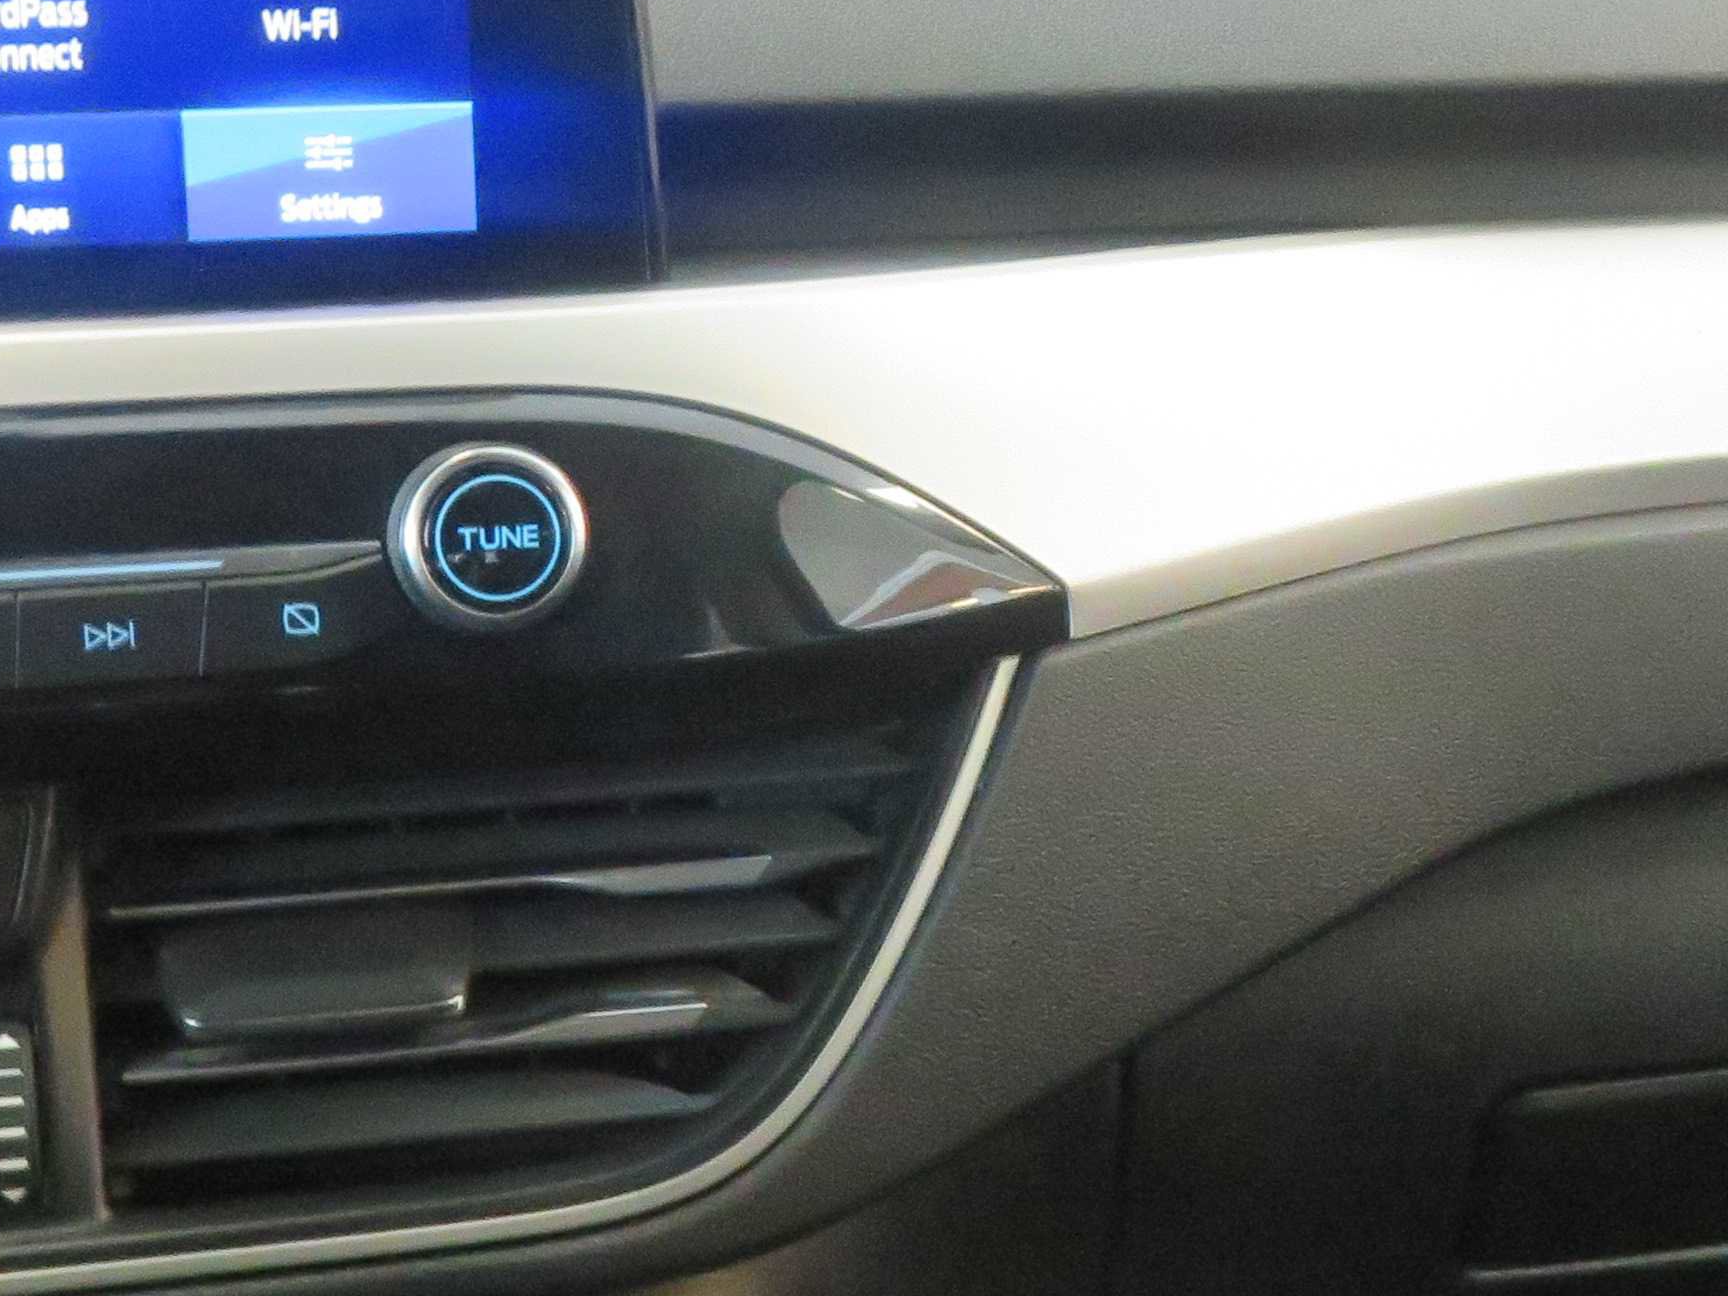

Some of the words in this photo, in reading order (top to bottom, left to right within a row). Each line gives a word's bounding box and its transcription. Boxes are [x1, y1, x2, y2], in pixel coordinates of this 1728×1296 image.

[262, 7, 339, 42] Wi-Fi
[10, 203, 70, 234] Apps
[280, 192, 384, 225] Settings
[457, 524, 540, 551] TUNE
